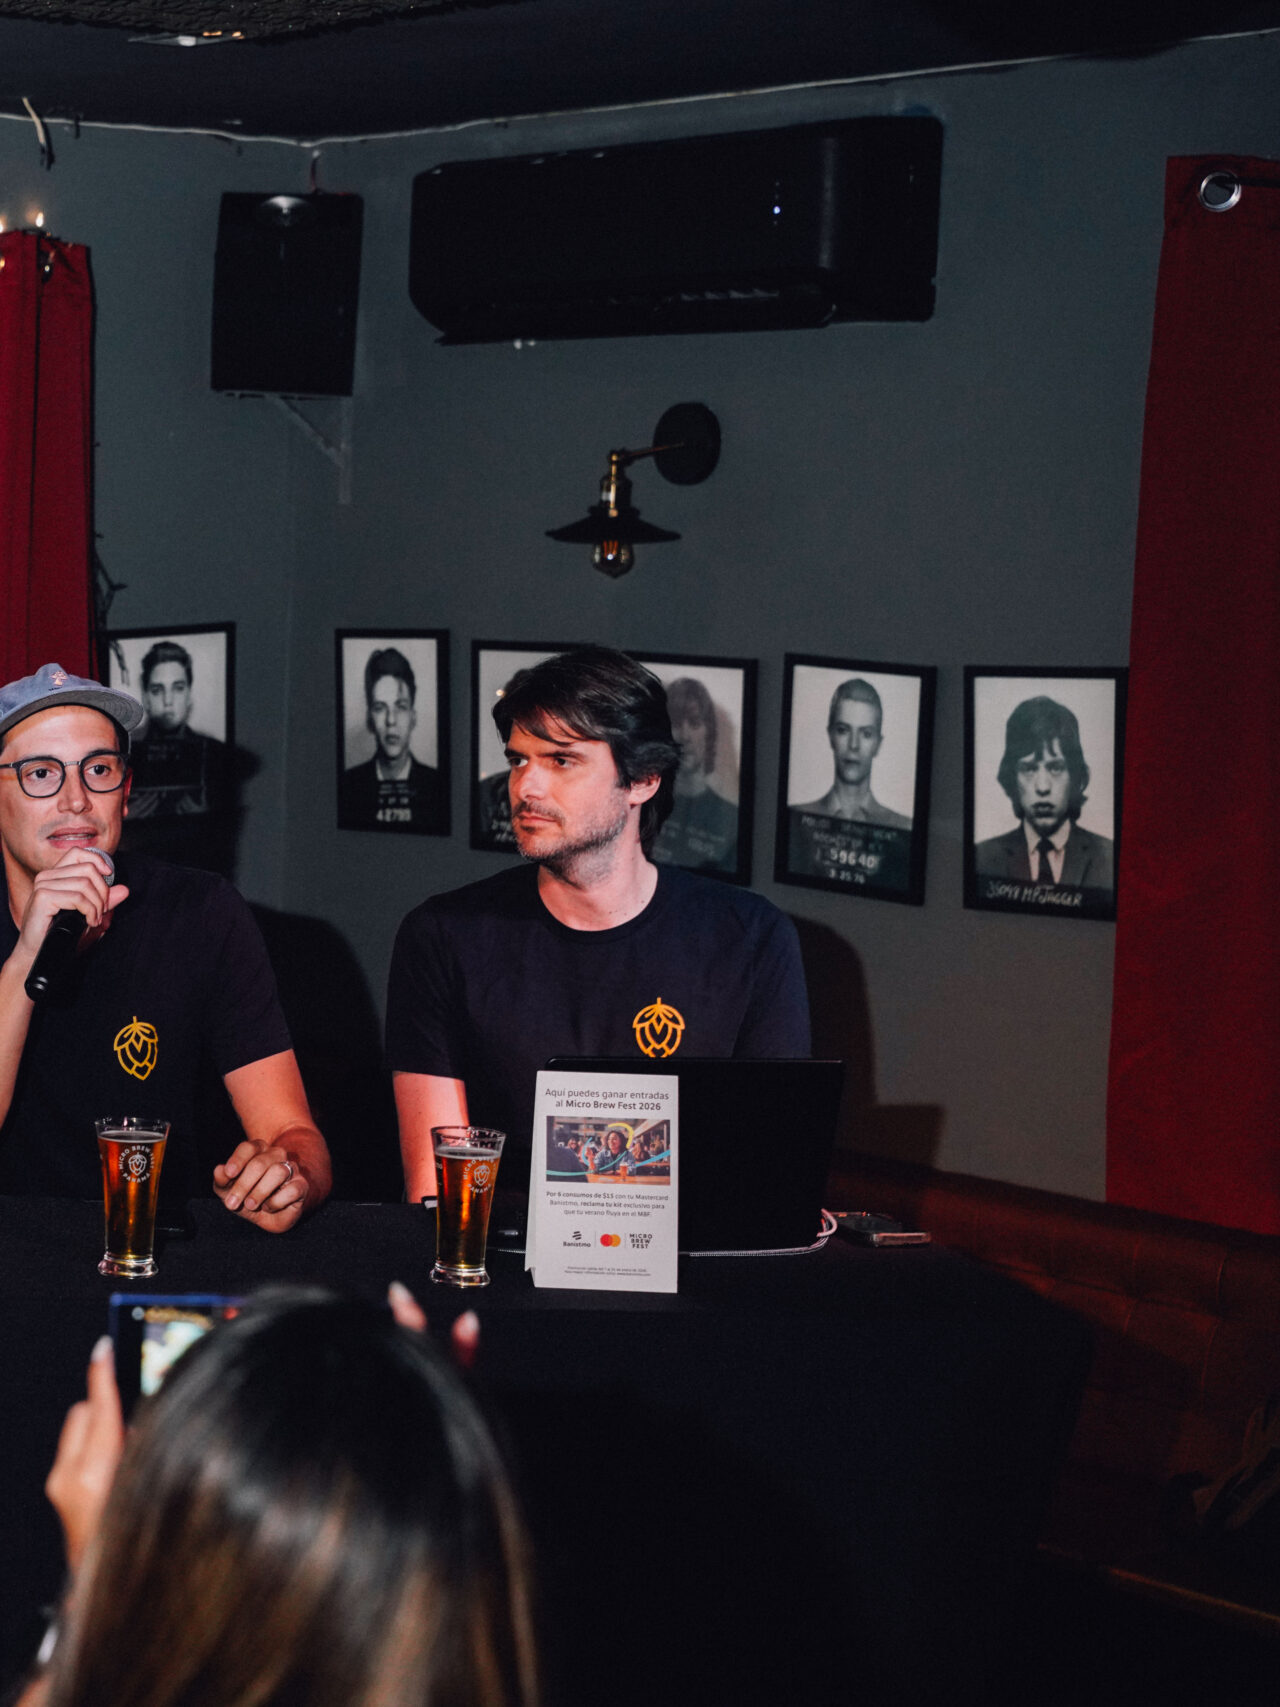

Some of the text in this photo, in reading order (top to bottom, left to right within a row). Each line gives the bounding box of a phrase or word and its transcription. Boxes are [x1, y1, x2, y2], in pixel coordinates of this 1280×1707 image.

[545, 1088, 669, 1100] Aquí puedes ganar entradas
[565, 1100, 591, 1109] Micro
[593, 1101, 615, 1109] Brew
[618, 1101, 637, 1110] Fest
[638, 1102, 661, 1111] 2026
[122, 1172, 151, 1183] PANAMA
